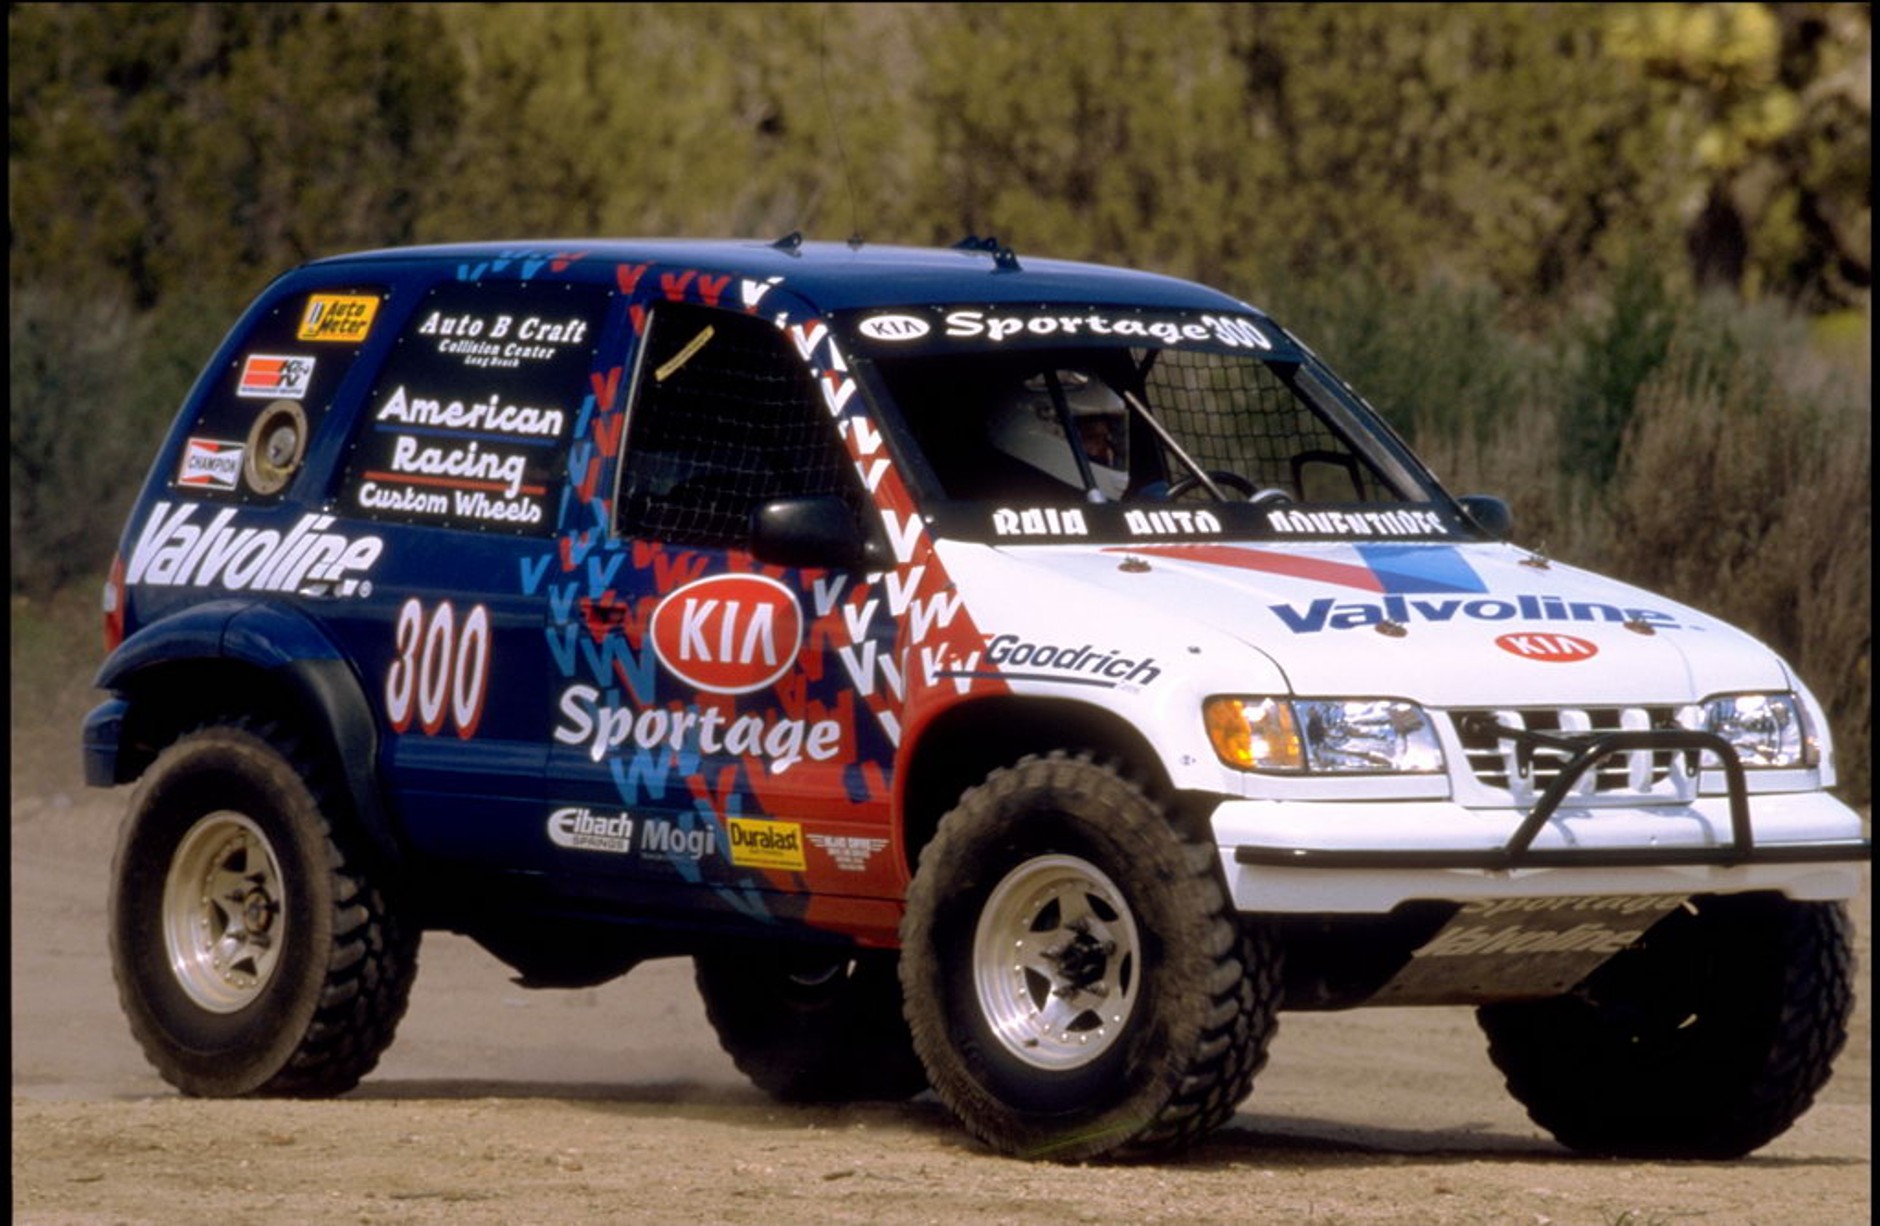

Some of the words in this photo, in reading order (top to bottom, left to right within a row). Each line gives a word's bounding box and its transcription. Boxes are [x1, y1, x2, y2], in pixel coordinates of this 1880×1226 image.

[319, 318, 368, 334] Meter
[327, 301, 367, 317] Auto
[419, 311, 484, 337] Auto
[489, 315, 513, 339] B
[518, 317, 587, 343] Craft
[438, 339, 501, 355] Collision
[504, 342, 555, 359] Center
[872, 316, 922, 336] KIA
[945, 311, 1209, 344] Sportage
[1202, 315, 1272, 351] 300
[464, 354, 490, 368] Long
[377, 386, 564, 436] American
[189, 455, 236, 472] CHAMPION
[392, 436, 527, 498] Racing
[358, 481, 448, 516] Custom
[454, 488, 542, 523] Wheels
[126, 502, 383, 596] Valvoline
[680, 598, 777, 665] KIA
[1269, 595, 1682, 634] Valvoline
[1517, 635, 1586, 656] KIA
[386, 598, 490, 738] 300
[553, 684, 841, 775] Sportage
[548, 808, 633, 851] Eibach
[641, 818, 715, 860] Mogi
[730, 822, 799, 851] Duralast
